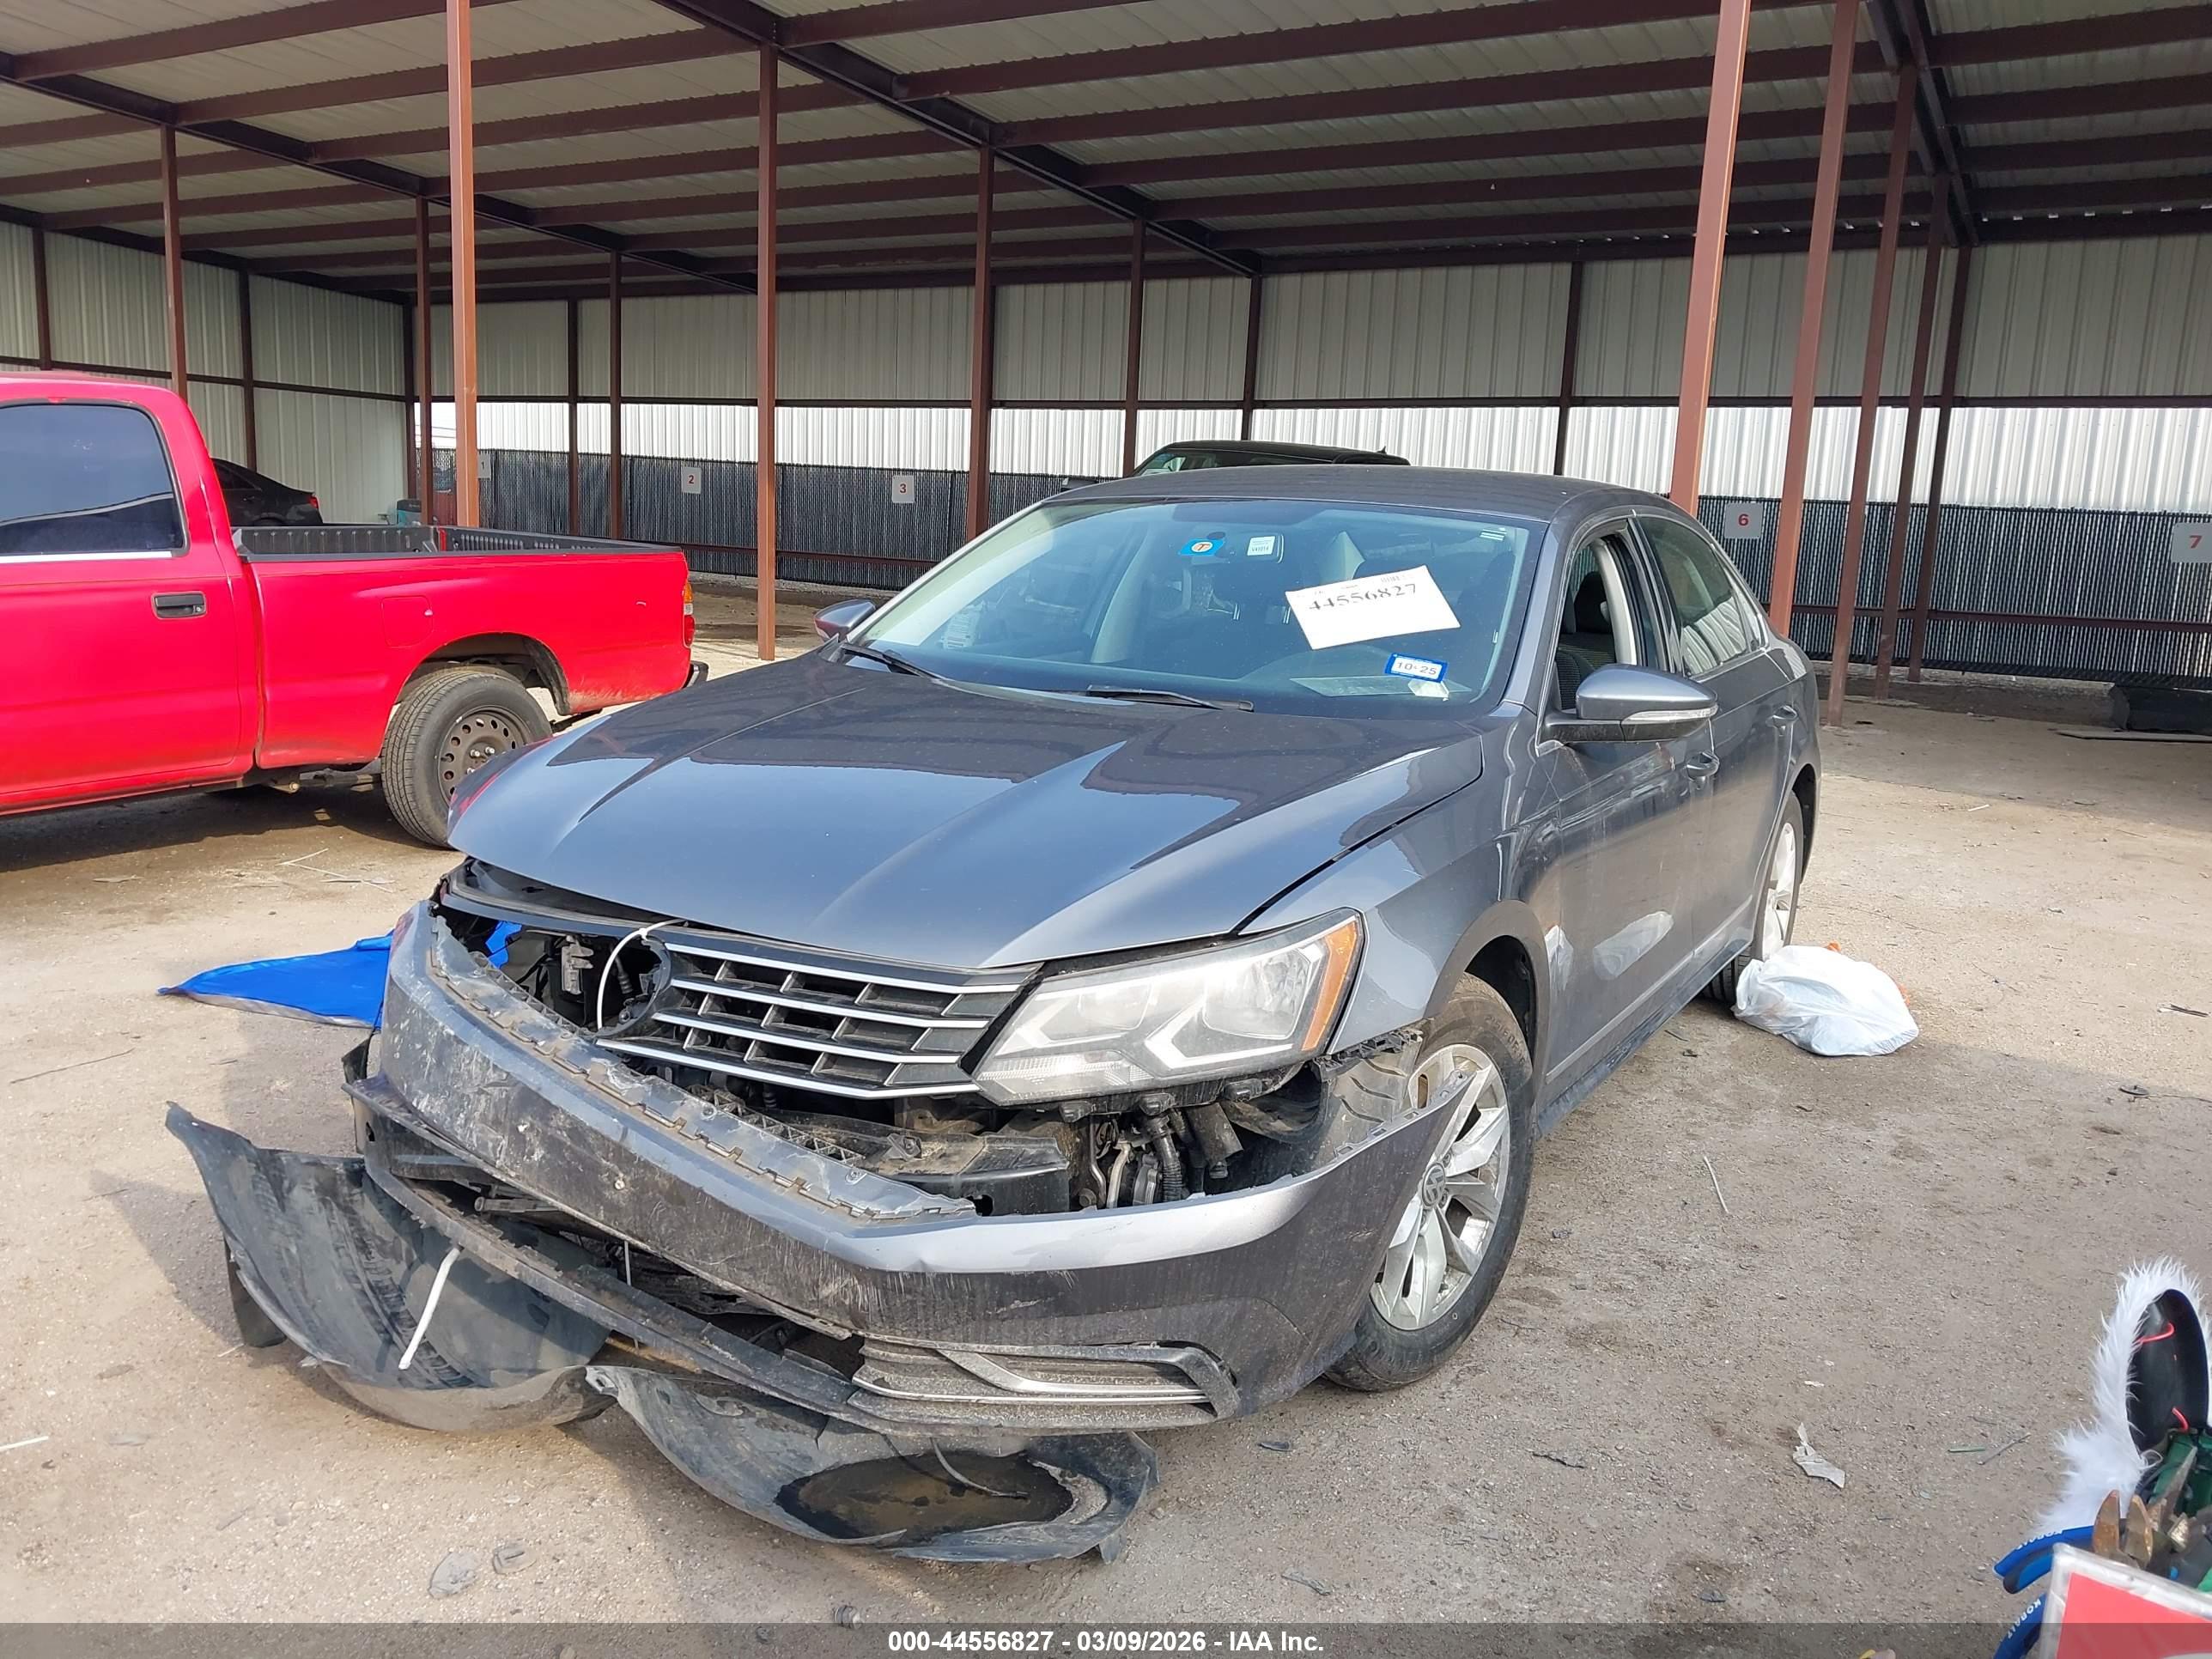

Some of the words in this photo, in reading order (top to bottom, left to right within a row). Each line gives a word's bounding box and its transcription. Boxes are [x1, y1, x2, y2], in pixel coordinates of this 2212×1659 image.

[688, 474, 695, 484] 2
[899, 483, 907, 494] 3
[1738, 514, 1748, 526] 6
[2189, 535, 2203, 549] 7
[1309, 583, 1416, 611] 44556827
